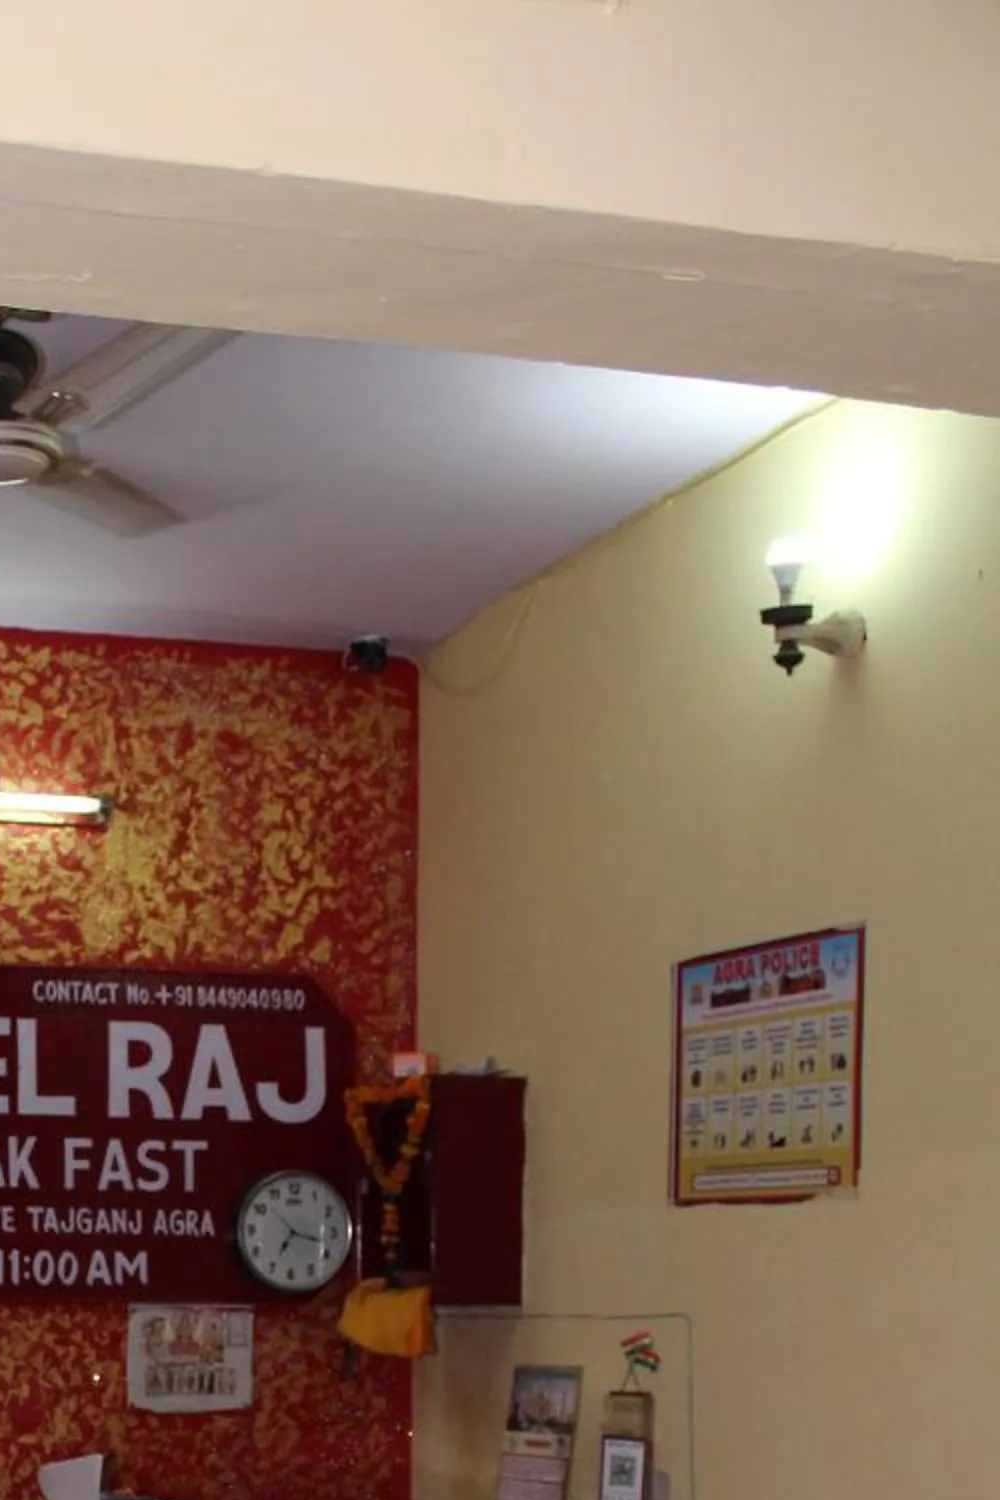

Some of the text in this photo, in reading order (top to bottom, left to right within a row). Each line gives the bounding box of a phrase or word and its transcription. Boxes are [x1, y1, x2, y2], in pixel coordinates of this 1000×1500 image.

[713, 958, 755, 986] AGRA
[760, 943, 820, 976] POLICE
[33, 980, 119, 1005] CONTACT
[107, 1020, 327, 1124] RAJ
[63, 1137, 208, 1192] FAST
[27, 1206, 142, 1235] TAJGANJ
[153, 1208, 215, 1237] AGRA
